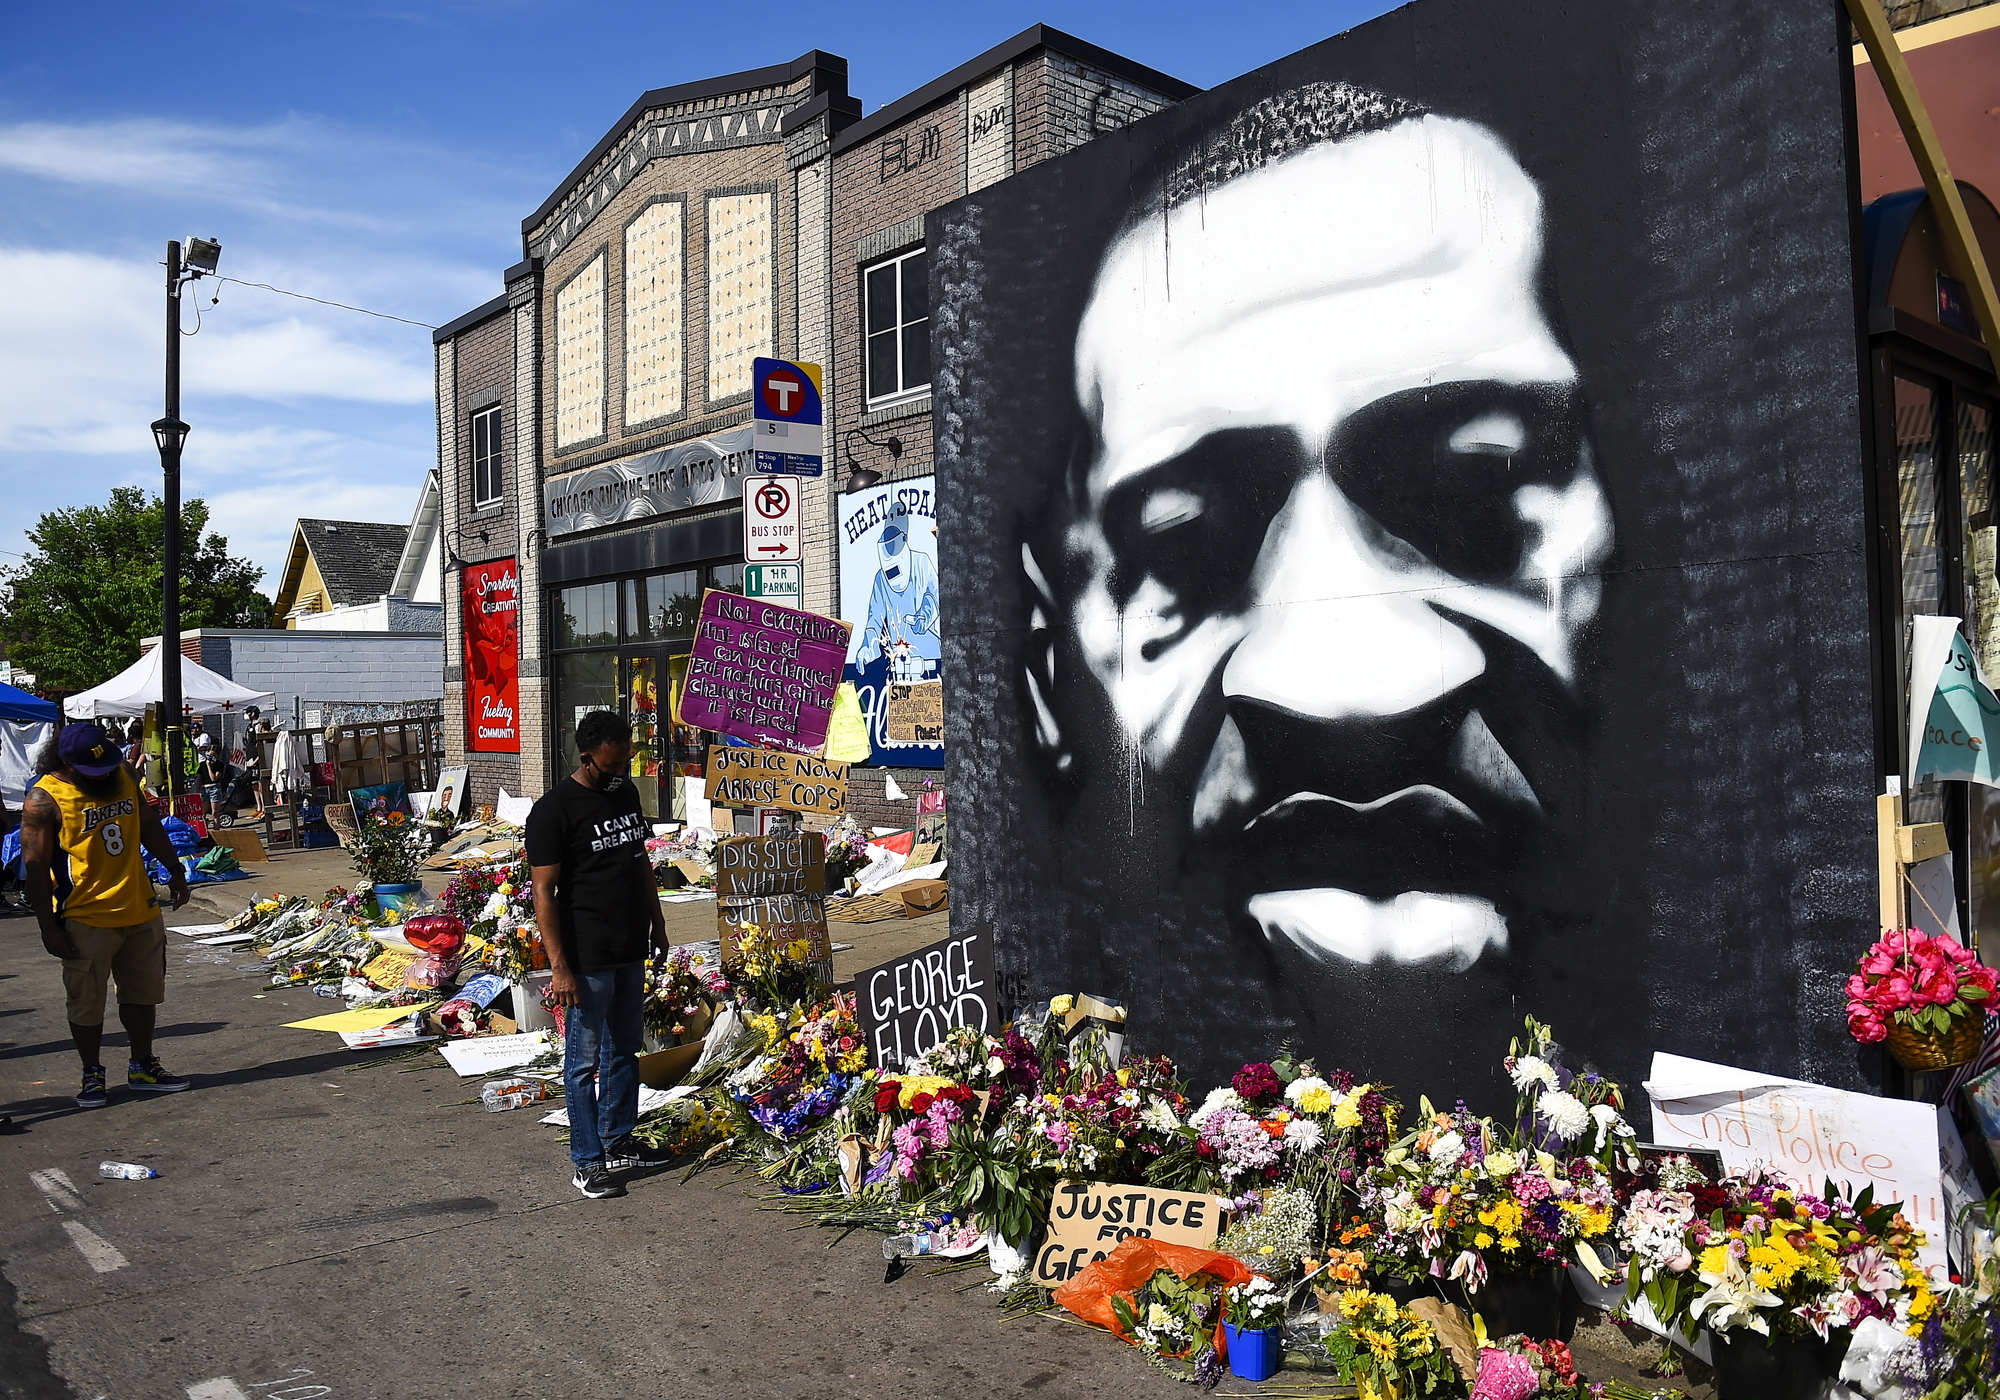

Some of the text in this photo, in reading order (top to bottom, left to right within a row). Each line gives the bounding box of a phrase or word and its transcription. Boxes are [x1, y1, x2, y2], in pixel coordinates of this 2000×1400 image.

[768, 379, 799, 411] T
[768, 423, 776, 434] 5
[758, 462, 773, 470] 794
[551, 491, 595, 519] CHICAGO
[648, 468, 676, 494] FIRE
[681, 458, 715, 489] ARTS
[752, 525, 795, 537] BUS STOP
[844, 493, 894, 544] HEAT,
[476, 569, 519, 598] Sparking
[750, 568, 788, 592] 1 HR
[763, 582, 797, 593] PARKING
[648, 612, 684, 630] 3749
[717, 598, 850, 647] Not everything
[738, 631, 754, 649] is
[755, 630, 800, 660] faced
[714, 645, 836, 689] can be changed
[689, 678, 801, 716] changed until
[722, 666, 783, 699] nothing
[787, 683, 814, 706] can
[817, 691, 835, 711] be
[891, 685, 912, 700] STOP
[480, 695, 513, 727] Fueling
[708, 699, 722, 714] it
[730, 705, 746, 723] is
[478, 725, 515, 739] COMMUNITY
[1923, 724, 1983, 752] eace
[81, 797, 135, 833] LAKERS
[594, 812, 639, 837] I CAN'T
[101, 822, 124, 857] 8
[591, 826, 645, 852] BREATHE
[870, 934, 984, 1021] GEORGE
[1769, 1094, 1897, 1182] Police
[1056, 1185, 1206, 1228] JUSTICE
